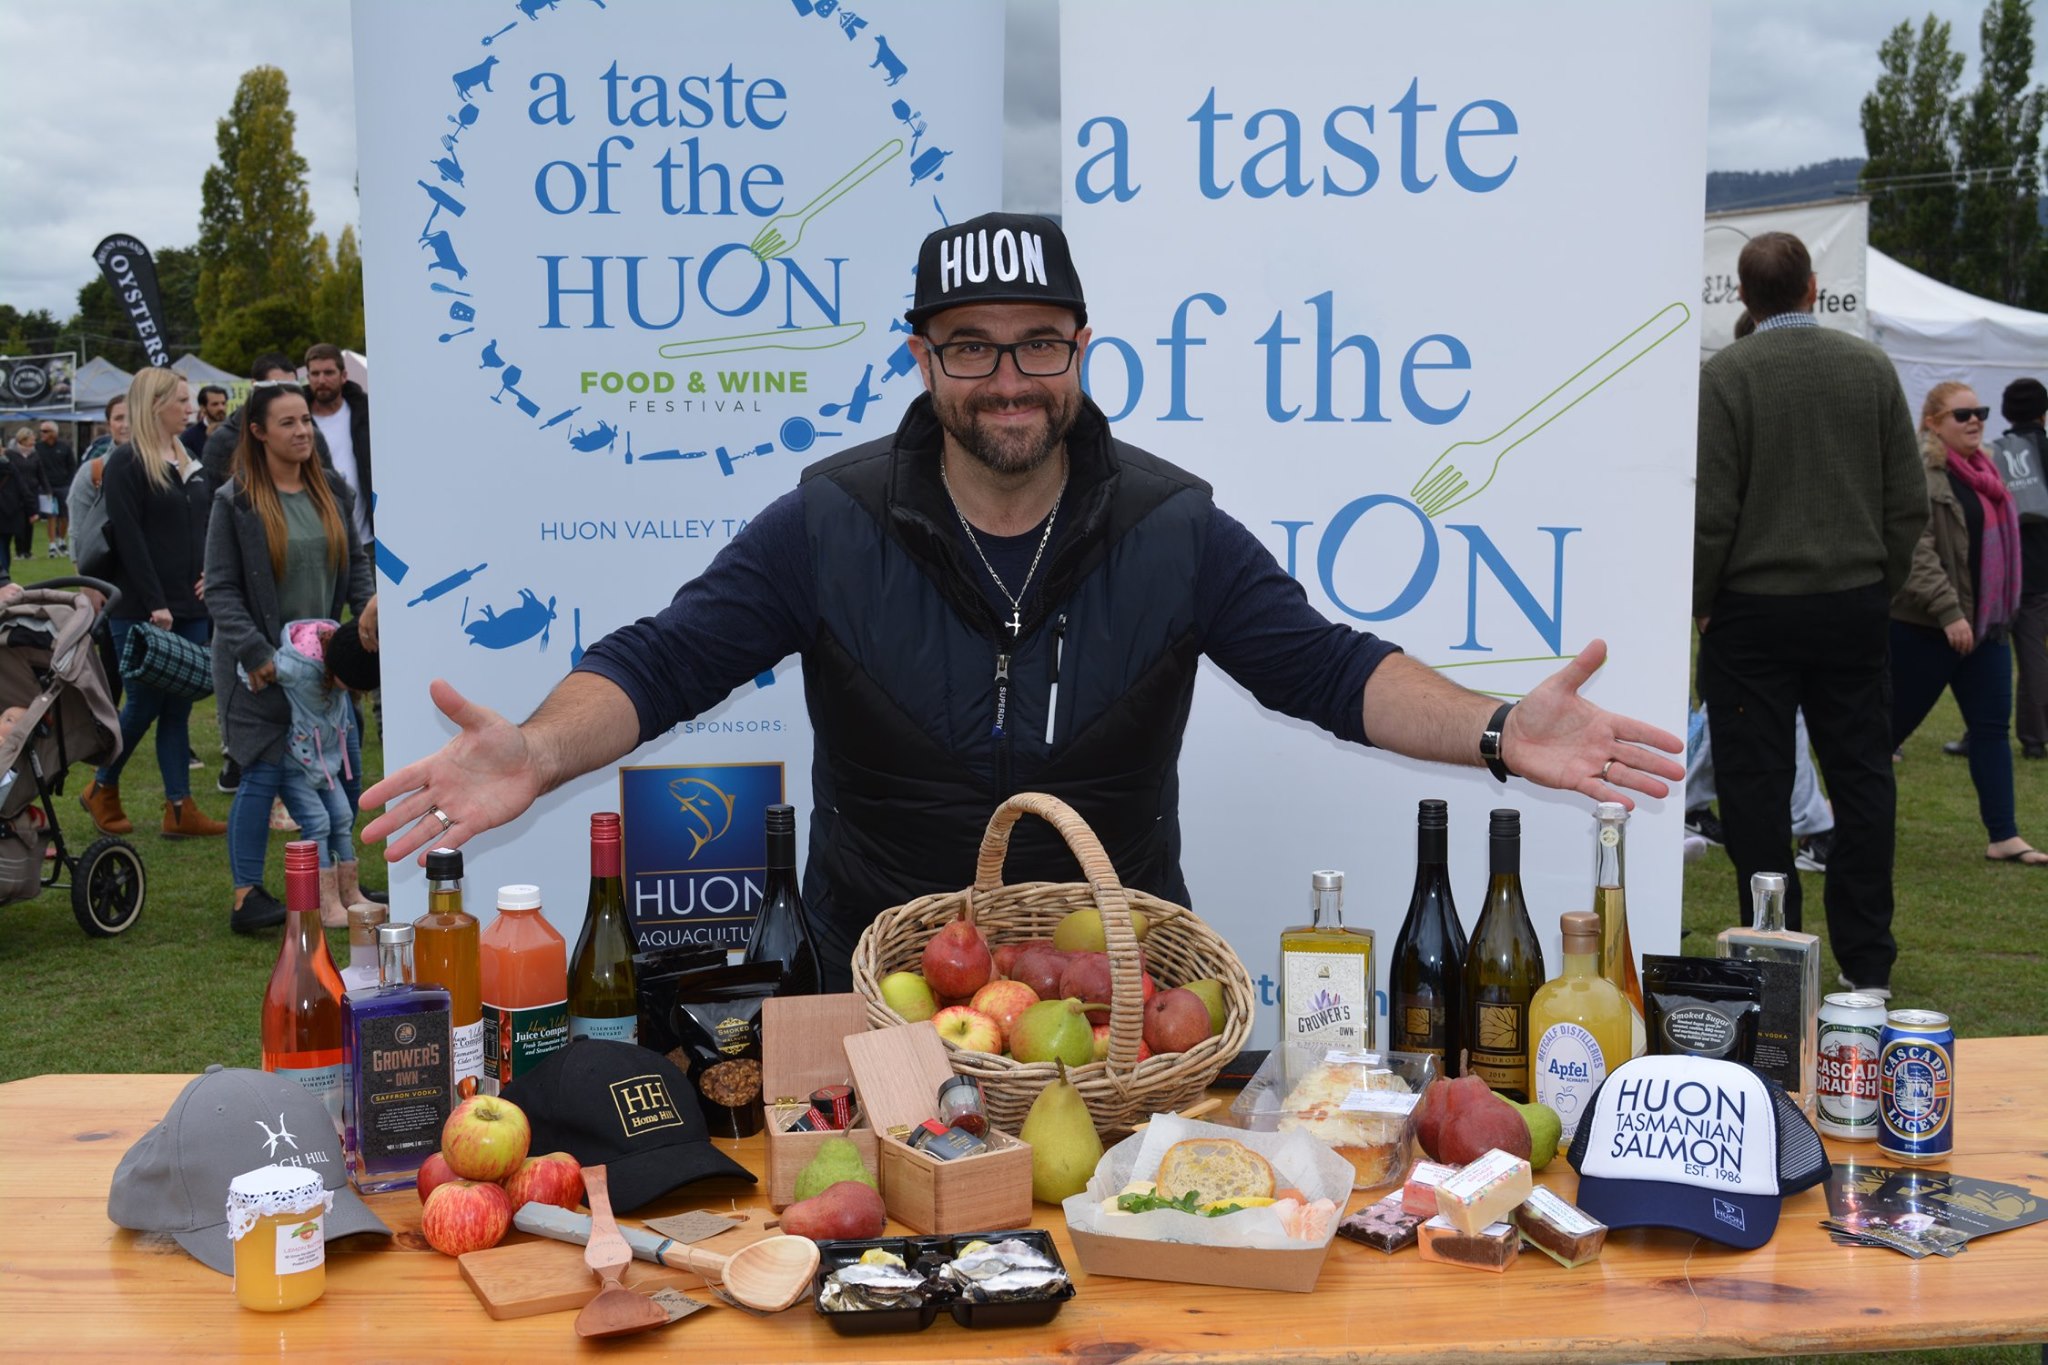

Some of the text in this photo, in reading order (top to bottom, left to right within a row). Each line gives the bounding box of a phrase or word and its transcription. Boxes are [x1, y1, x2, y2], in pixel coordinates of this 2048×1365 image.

[528, 59, 788, 130] a taste
[1074, 76, 1519, 205] a taste
[535, 135, 785, 218] of the
[940, 228, 1048, 294] HUON
[536, 242, 850, 331] HUON
[110, 255, 169, 367] OYSTERS
[1080, 290, 1473, 426] of the
[580, 371, 808, 394] FOOD & WINE
[628, 400, 763, 413] FESTIVAL
[541, 521, 616, 541] HUON
[624, 520, 715, 539] VALLEY
[996, 686, 1007, 730] SUPERDRY
[718, 1025, 750, 1036] SMOKED
[1298, 1005, 1351, 1034] GROWER'S
[1671, 1011, 1730, 1027] Smoked Sugar
[515, 1032, 539, 1043] Juice
[1538, 1025, 1604, 1069] METCALF DISTILLERIES
[373, 1043, 440, 1072] GROWER'S
[1548, 1058, 1588, 1080] Apfel
[1884, 1047, 1947, 1080] CASCADE
[303, 1079, 335, 1087] VINEYARD
[395, 1071, 419, 1087] OWN
[375, 1089, 437, 1102] SAFFRON VODKA
[620, 1082, 670, 1115] HH
[1616, 1079, 1746, 1126] HUON
[631, 1110, 675, 1127] Home Hill
[1616, 1113, 1744, 1147] TASMANIAN
[1887, 1107, 1941, 1133] LAGER
[271, 1151, 330, 1168] CH HILL
[1611, 1133, 1743, 1173] SALMON
[1684, 1163, 1742, 1184] EST. 1986
